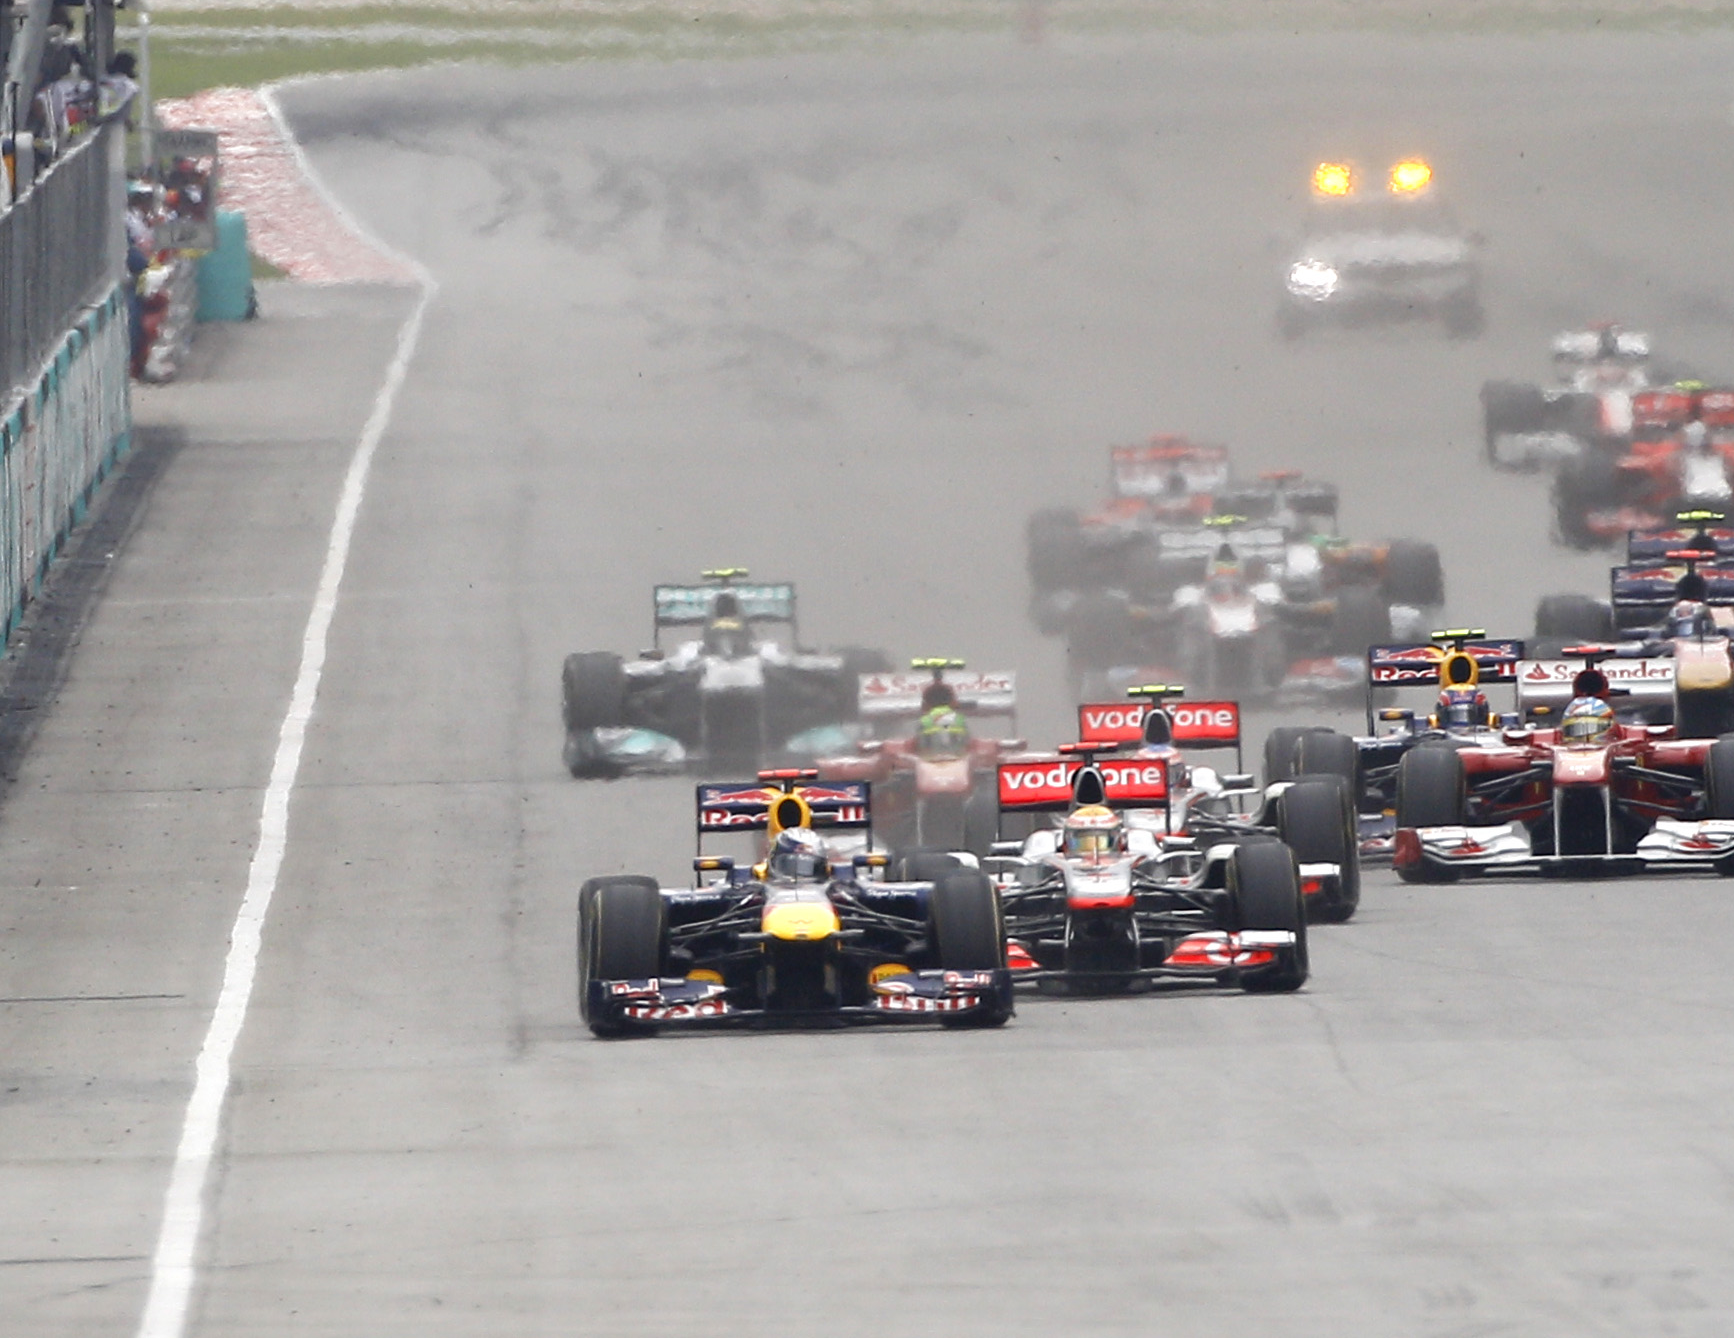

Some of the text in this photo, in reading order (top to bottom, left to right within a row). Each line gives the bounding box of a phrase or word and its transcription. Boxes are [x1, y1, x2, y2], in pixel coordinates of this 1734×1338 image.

[1554, 661, 1672, 680] Saander
[1085, 704, 1234, 729] vodone
[1002, 763, 1161, 789] vodone
